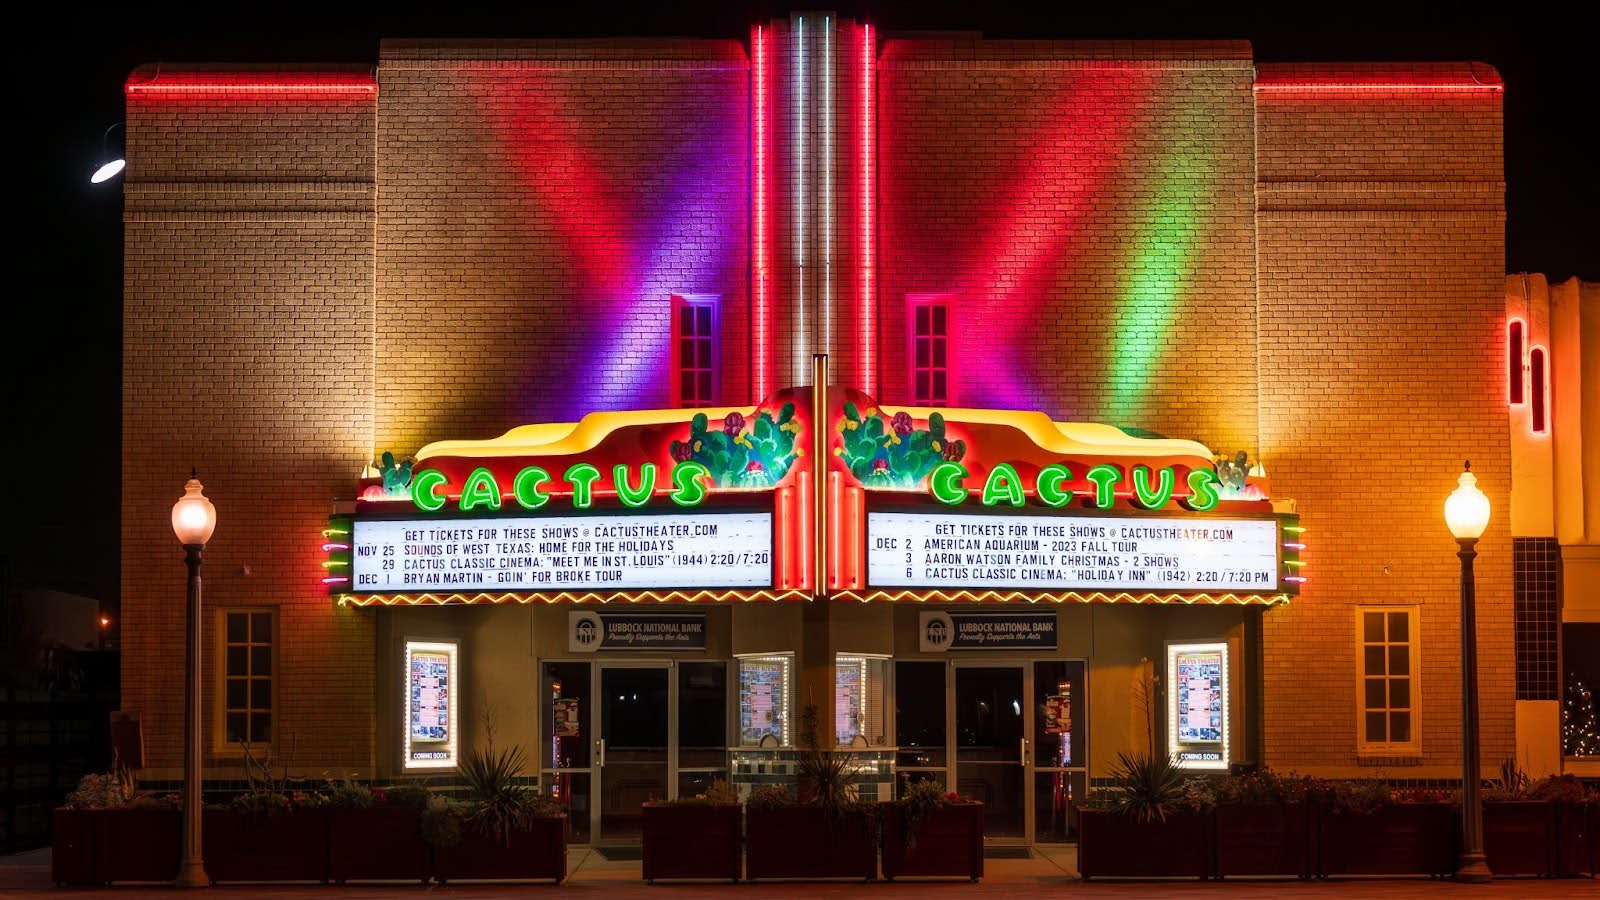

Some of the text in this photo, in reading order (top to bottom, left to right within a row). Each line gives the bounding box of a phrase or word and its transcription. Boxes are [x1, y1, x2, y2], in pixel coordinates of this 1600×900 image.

[411, 461, 708, 511] CACTUS
[931, 461, 1219, 511] CACTUS
[405, 530, 424, 541] GET
[430, 530, 473, 540] TICKETS
[478, 529, 497, 540] FOR
[504, 529, 536, 539] THESE
[542, 527, 578, 538] SHOWS
[595, 525, 718, 537] CACTUSTHEATER.COM
[936, 524, 955, 535] GET
[961, 525, 1004, 535] TICKETS
[1009, 526, 1027, 536] FOR
[1033, 526, 1065, 536] THESE
[1070, 527, 1105, 537] SHOWS
[1122, 528, 1233, 540] CACTUSTHEATER.COM
[358, 540, 674, 556] NOV 25 SOUNDS OF WEST TEXAS: HOME FOR THE HOLIDAYS
[877, 538, 897, 548] DEC
[906, 539, 912, 549] 2
[925, 539, 980, 550] AMERICAN
[985, 540, 1039, 550] AQUARIUM
[1052, 541, 1077, 551] 2023
[1082, 542, 1108, 551] FALL
[1112, 542, 1137, 552] TOUR
[383, 560, 394, 569] 29
[405, 560, 445, 569] CACTUS
[451, 558, 495, 569] CLASSIC
[500, 557, 543, 568] CINEMA:
[584, 556, 598, 566] ME
[602, 556, 611, 566] IN
[673, 554, 708, 565] (1944)
[906, 554, 912, 563] 3
[925, 554, 961, 564] AARON
[967, 554, 1011, 565] WATSON
[1016, 555, 1055, 565] FAMILY
[1062, 555, 1119, 566] CHRISTMAS
[1134, 556, 1139, 566] 2
[1144, 557, 1179, 567] SHOWS
[360, 574, 378, 584] DEC
[405, 573, 439, 584] BRYAN
[444, 572, 483, 583] MARTIN
[533, 572, 551, 582] FOR
[557, 571, 590, 581] BROKE
[596, 571, 622, 581] TOUR
[906, 568, 912, 578] 6
[926, 568, 968, 579] CACTUS
[973, 569, 1016, 579] CLASSIC
[1022, 569, 1066, 580] CINEMA:
[1158, 571, 1190, 581] (1942)
[1255, 573, 1269, 582] PM
[609, 624, 702, 632] LUBBOCK NATIONAL BANK
[960, 623, 1053, 631] LUBBOCK NATIONAL BANK
[608, 634, 634, 643] Proudly
[636, 633, 663, 642] Supports
[960, 633, 985, 643] Proudly
[986, 633, 1014, 641] Supports
